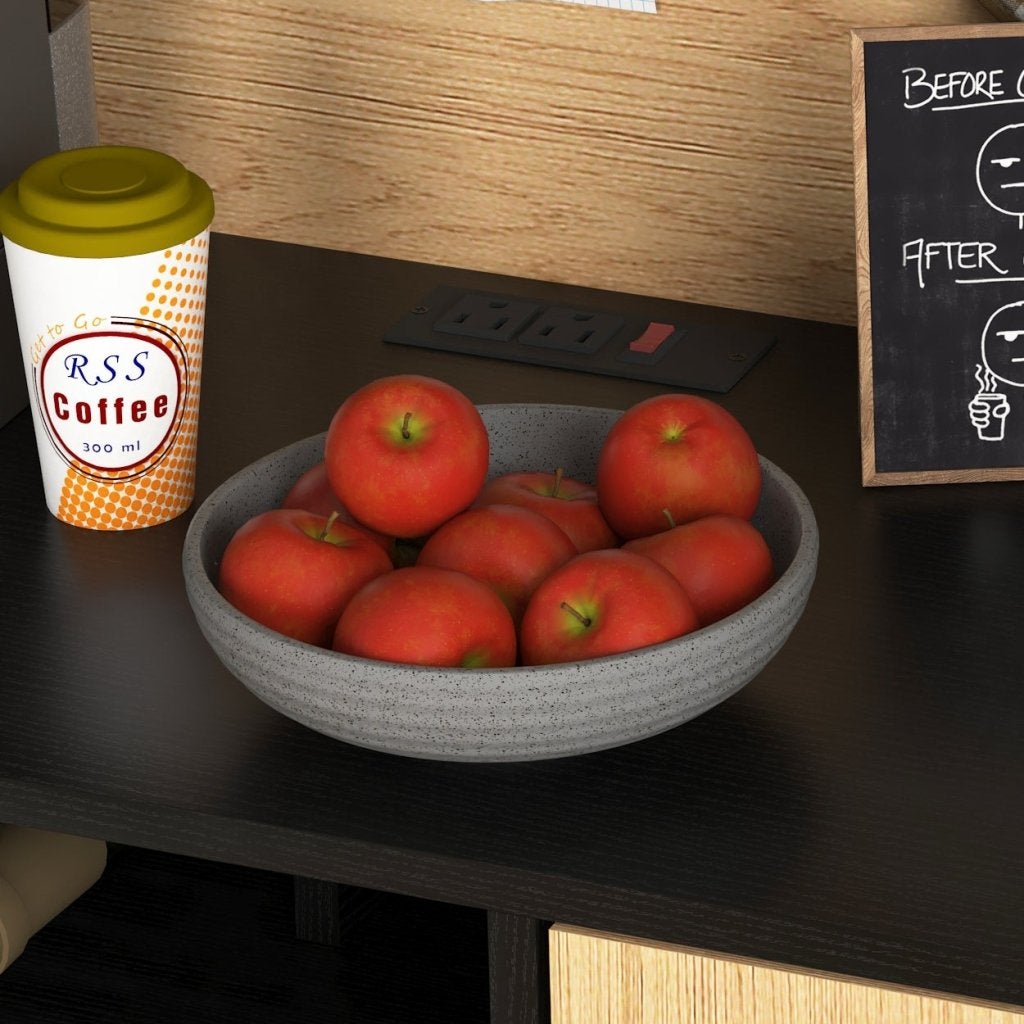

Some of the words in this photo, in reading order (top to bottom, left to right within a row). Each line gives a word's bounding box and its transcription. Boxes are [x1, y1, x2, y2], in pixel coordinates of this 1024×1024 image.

[46, 323, 64, 339] to
[74, 313, 107, 329] Go
[64, 351, 149, 386] RSS
[53, 392, 168, 425] Coffee
[82, 442, 113, 453] 300
[121, 440, 140, 452] ml
